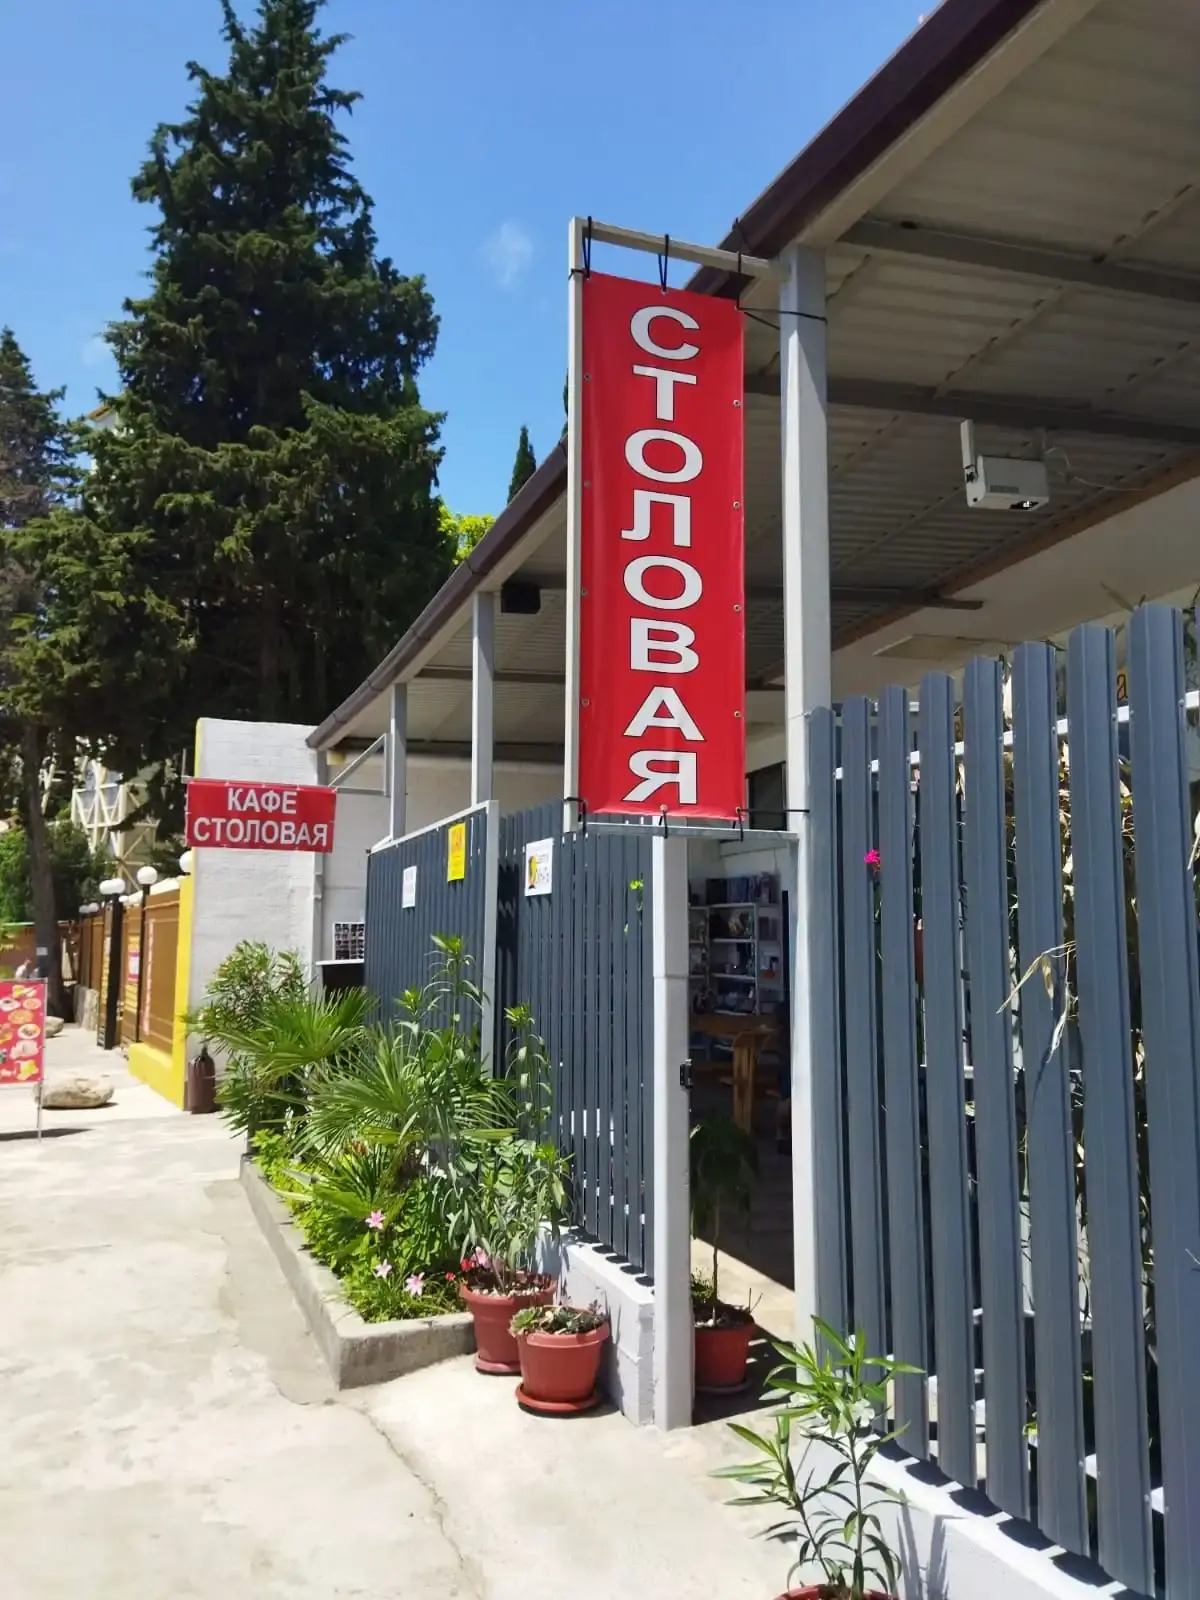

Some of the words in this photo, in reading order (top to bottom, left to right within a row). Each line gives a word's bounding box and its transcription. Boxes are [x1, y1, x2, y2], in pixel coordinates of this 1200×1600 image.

[621, 305, 704, 805] СТОЛОВАЯ
[227, 787, 298, 814] КАФЕ
[193, 817, 328, 847] СТОЛОВАЯ
